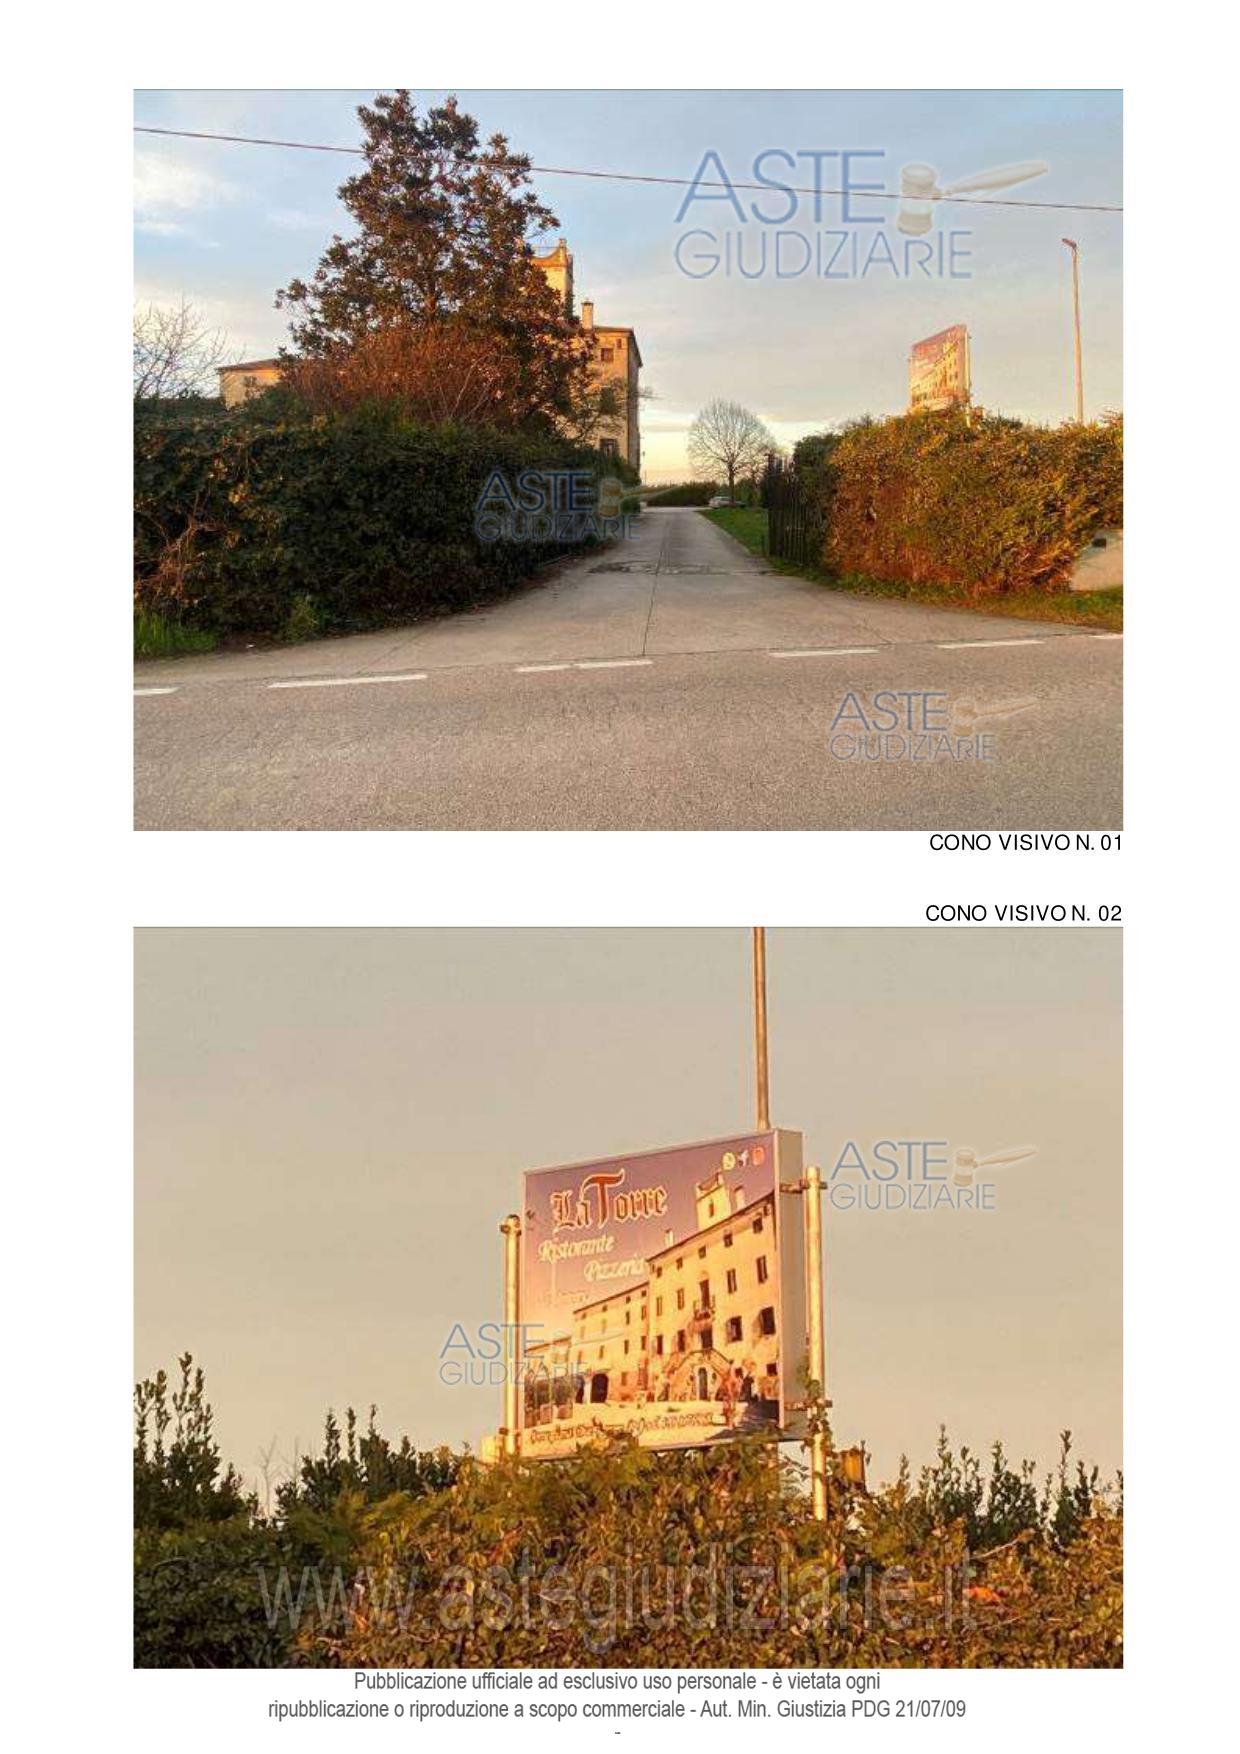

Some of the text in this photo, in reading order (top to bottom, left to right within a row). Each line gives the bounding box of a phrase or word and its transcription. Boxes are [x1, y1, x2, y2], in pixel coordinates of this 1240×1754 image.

[551, 1168, 668, 1233] La Torre
[538, 1234, 615, 1264] Ristorante
[584, 1254, 647, 1282] Pizzeria
